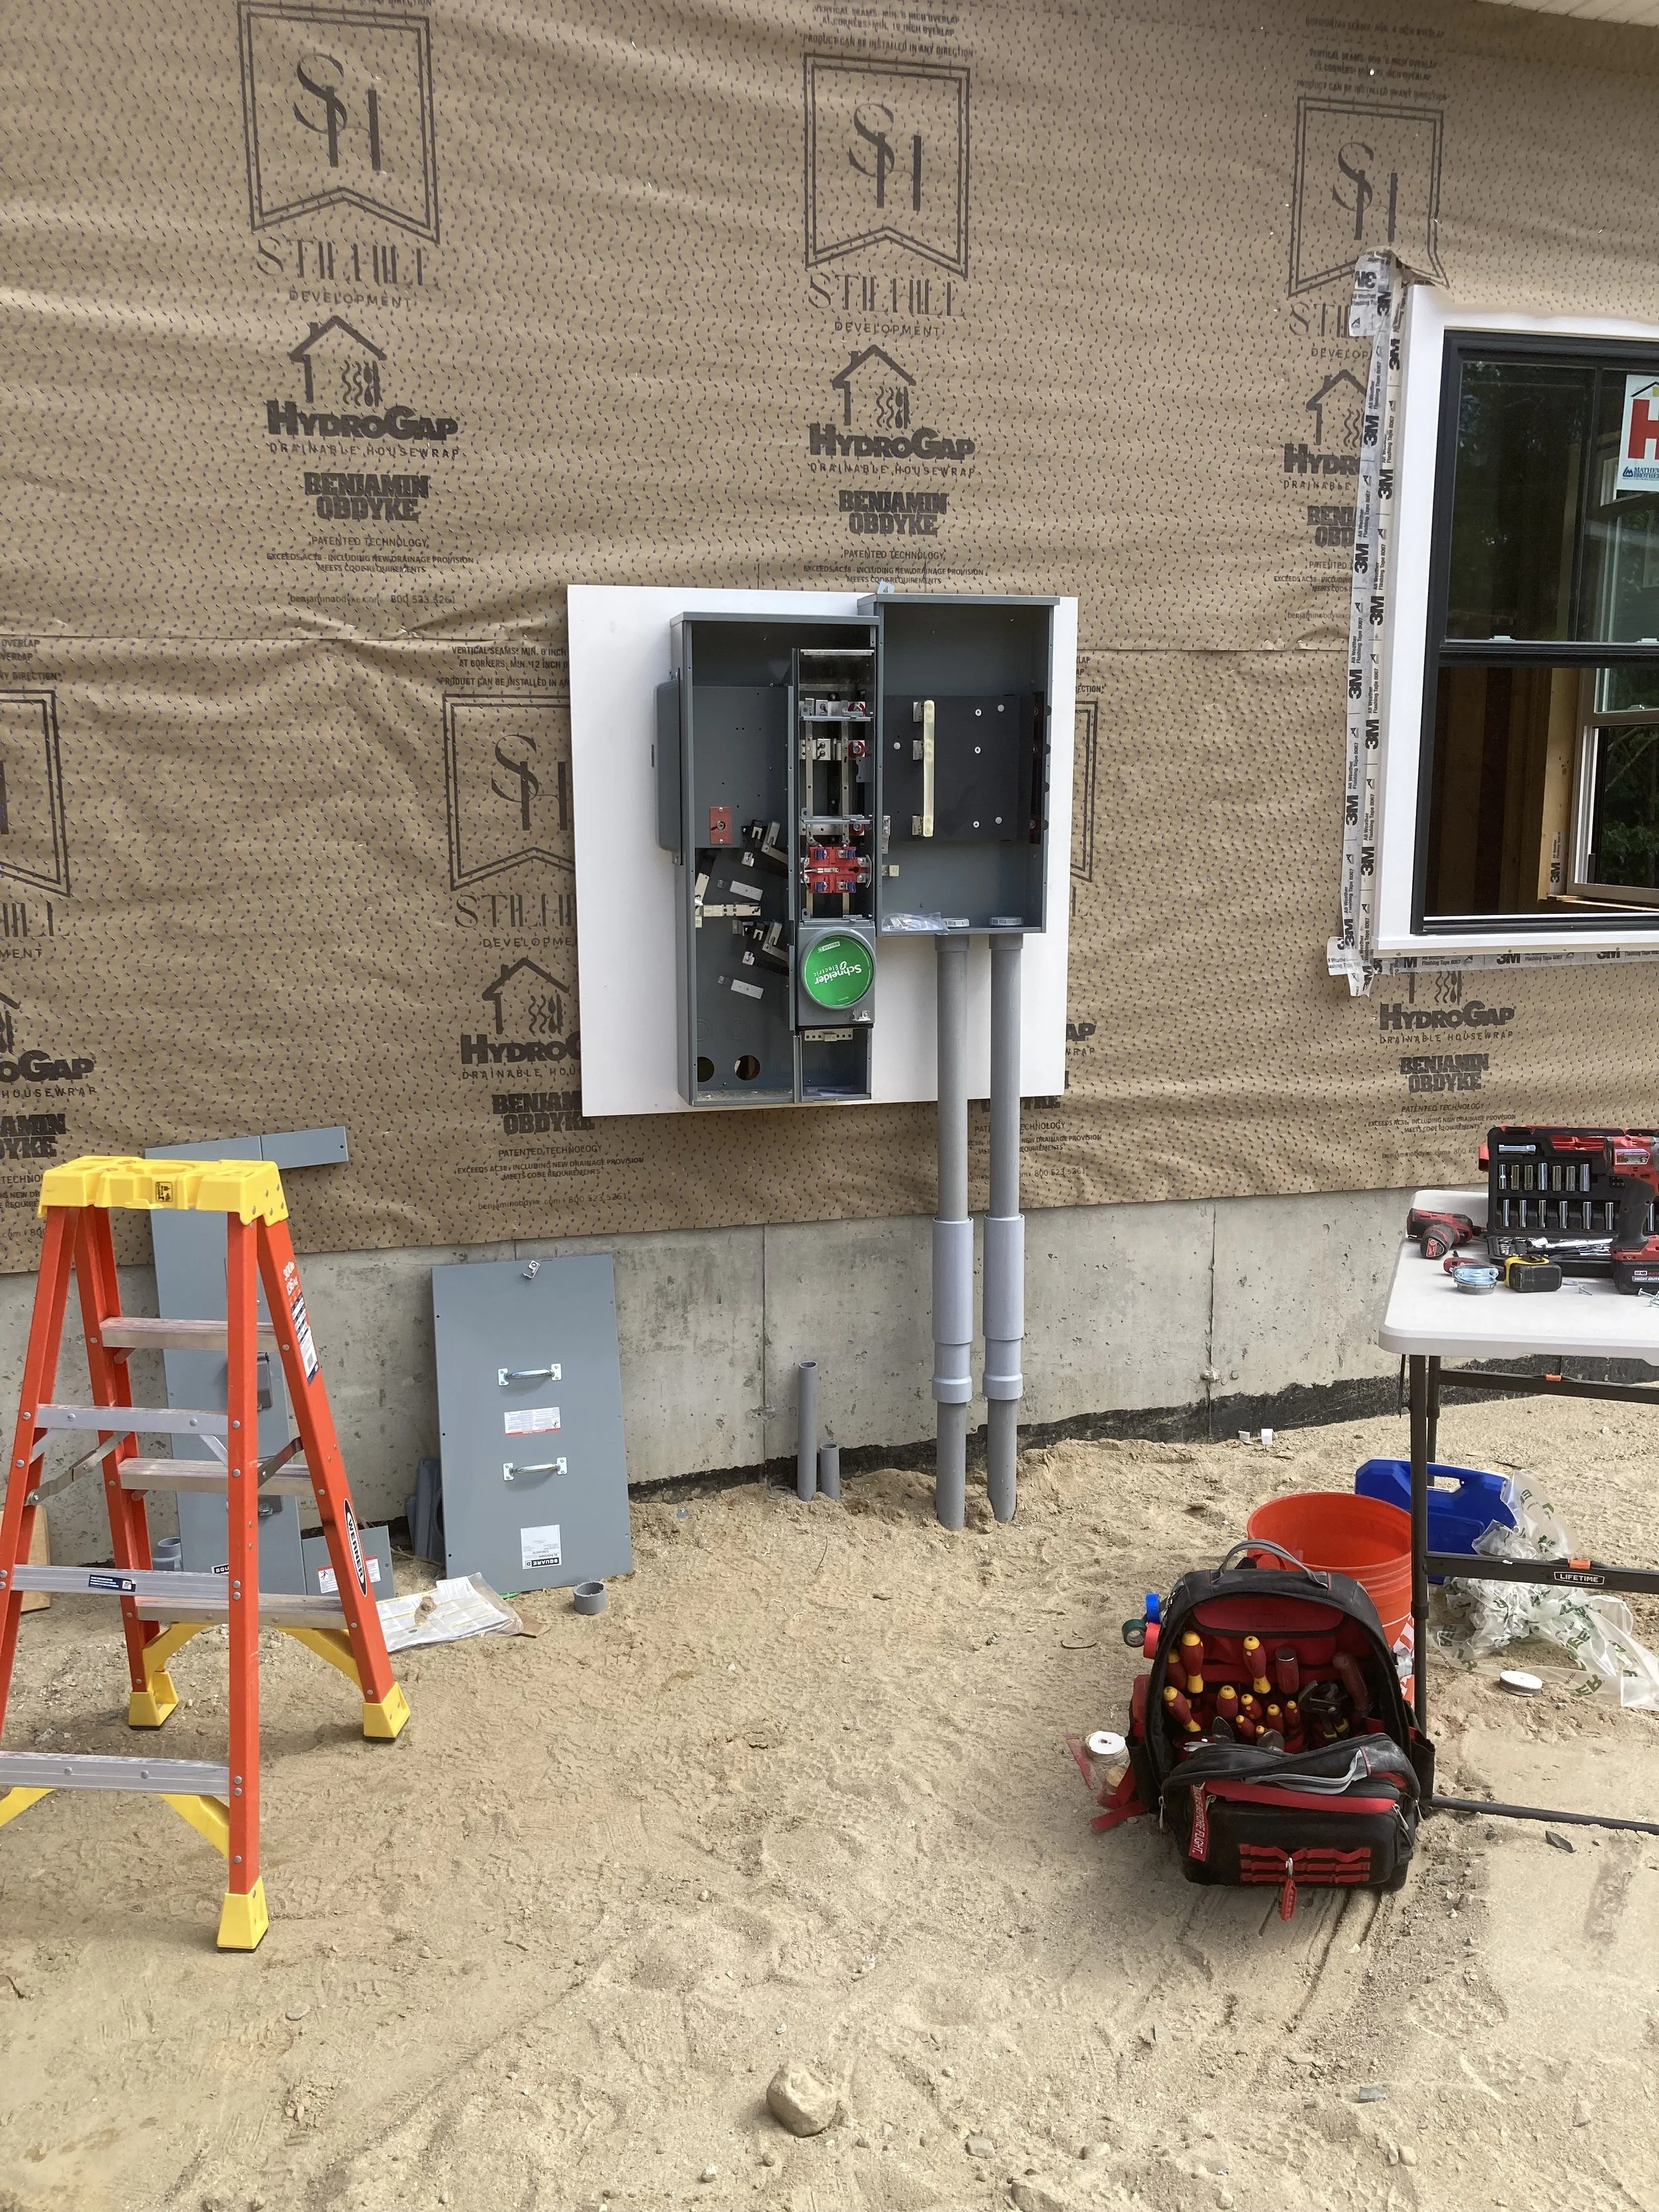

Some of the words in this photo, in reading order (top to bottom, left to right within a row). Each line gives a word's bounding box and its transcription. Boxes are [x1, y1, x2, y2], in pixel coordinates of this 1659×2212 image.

[289, 290, 411, 309] DEVELOPMENT
[835, 321, 940, 336] DEVELOPMENT
[1364, 415, 1379, 447] 3M
[269, 442, 358, 456] DRAINABLE
[366, 445, 459, 459] HOUSEWRAP
[1283, 443, 1360, 476] HYDR
[810, 463, 887, 475] DRAINABLE
[895, 465, 975, 477] HOUSEWRAP
[303, 472, 430, 498] BENJAMIN
[1283, 480, 1352, 491] DRAINABLE
[1378, 469, 1394, 500] 3M
[316, 496, 420, 522] OBDYKE
[838, 490, 948, 514] BENJAMIN
[849, 513, 938, 536] OBDYKE
[311, 536, 361, 546] PATENTED
[365, 536, 427, 548] TECHNOLOGY
[266, 553, 301, 561] EXCEEDS
[327, 554, 370, 563] INCLUDING
[372, 554, 390, 563] NEW
[391, 554, 431, 563] DRAINAGE
[432, 555, 474, 564] PROVISION
[843, 549, 887, 559] PATENTED
[889, 550, 945, 560] TECHNOLOGY
[1354, 544, 1369, 574] 3M
[856, 565, 894, 575] INCLUDING
[895, 566, 911, 575] NEW
[912, 567, 946, 575] DRAINAGE
[947, 567, 983, 576] PROVISION
[1369, 596, 1384, 627] 3M
[451, 646, 488, 655] VERTICAL
[478, 677, 493, 686] CAN
[495, 678, 505, 686] BE
[508, 677, 546, 687] INSTALLED
[559, 678, 569, 687] AN
[1348, 669, 1362, 700] 3M
[1365, 719, 1380, 750] 3M
[1346, 795, 1359, 826] 3M
[1360, 846, 1375, 876] 3M
[1345, 919, 1354, 947] 3M
[813, 964, 839, 977] Electric
[814, 964, 862, 985] Schneider
[1380, 1033, 1441, 1044] DRAINABLE
[1448, 1030, 1513, 1042] HOUSEWRAP
[462, 1067, 543, 1080] DRAINABLE
[1400, 1053, 1490, 1075] BENJAMIN
[1408, 1072, 1482, 1093] OBDYKE
[1, 1087, 98, 1098] HOUSEWRAP
[498, 1147, 543, 1158] PATENTED
[545, 1144, 603, 1155] TECHNOLOGY
[457, 1165, 488, 1175] EXCEEDS
[512, 1161, 551, 1171] INCLUDING
[569, 1158, 605, 1168] DRAINAGE
[607, 1157, 644, 1165] PROVISION
[503, 1172, 526, 1181] MEETS
[547, 1168, 601, 1178] REQUIREMENTS
[348, 1518, 363, 1578] WERNER
[1559, 1574, 1599, 1583] LIFETIME
